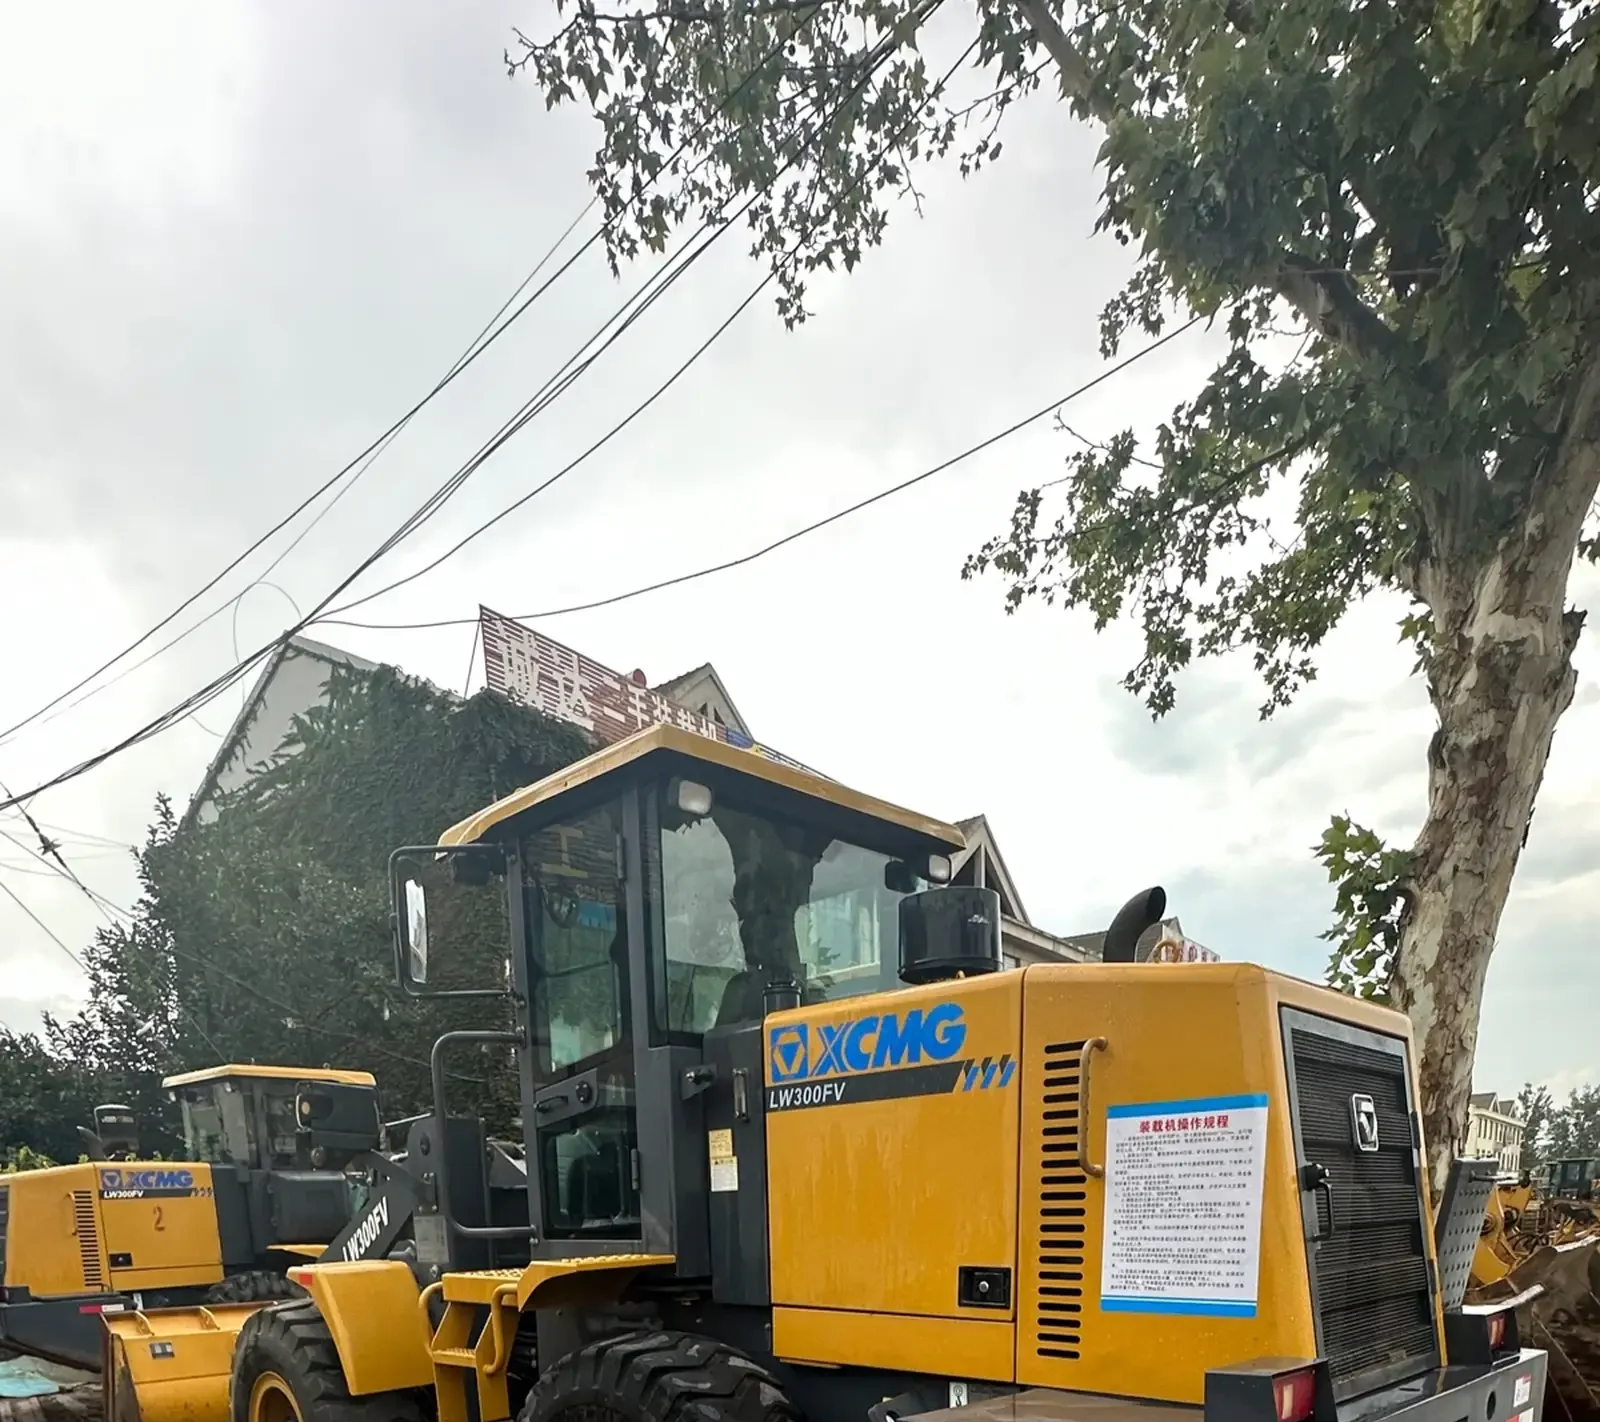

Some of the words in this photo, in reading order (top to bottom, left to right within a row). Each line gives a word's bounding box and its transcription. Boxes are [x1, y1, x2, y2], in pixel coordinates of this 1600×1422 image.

[809, 1003, 967, 1077] XCMG
[769, 1082, 846, 1109] LW300FV
[1139, 1114, 1230, 1133] 装载机操作规程
[125, 1170, 193, 1188] XCMG
[104, 1190, 144, 1199] LW300FV
[342, 1196, 388, 1262] LW300FV
